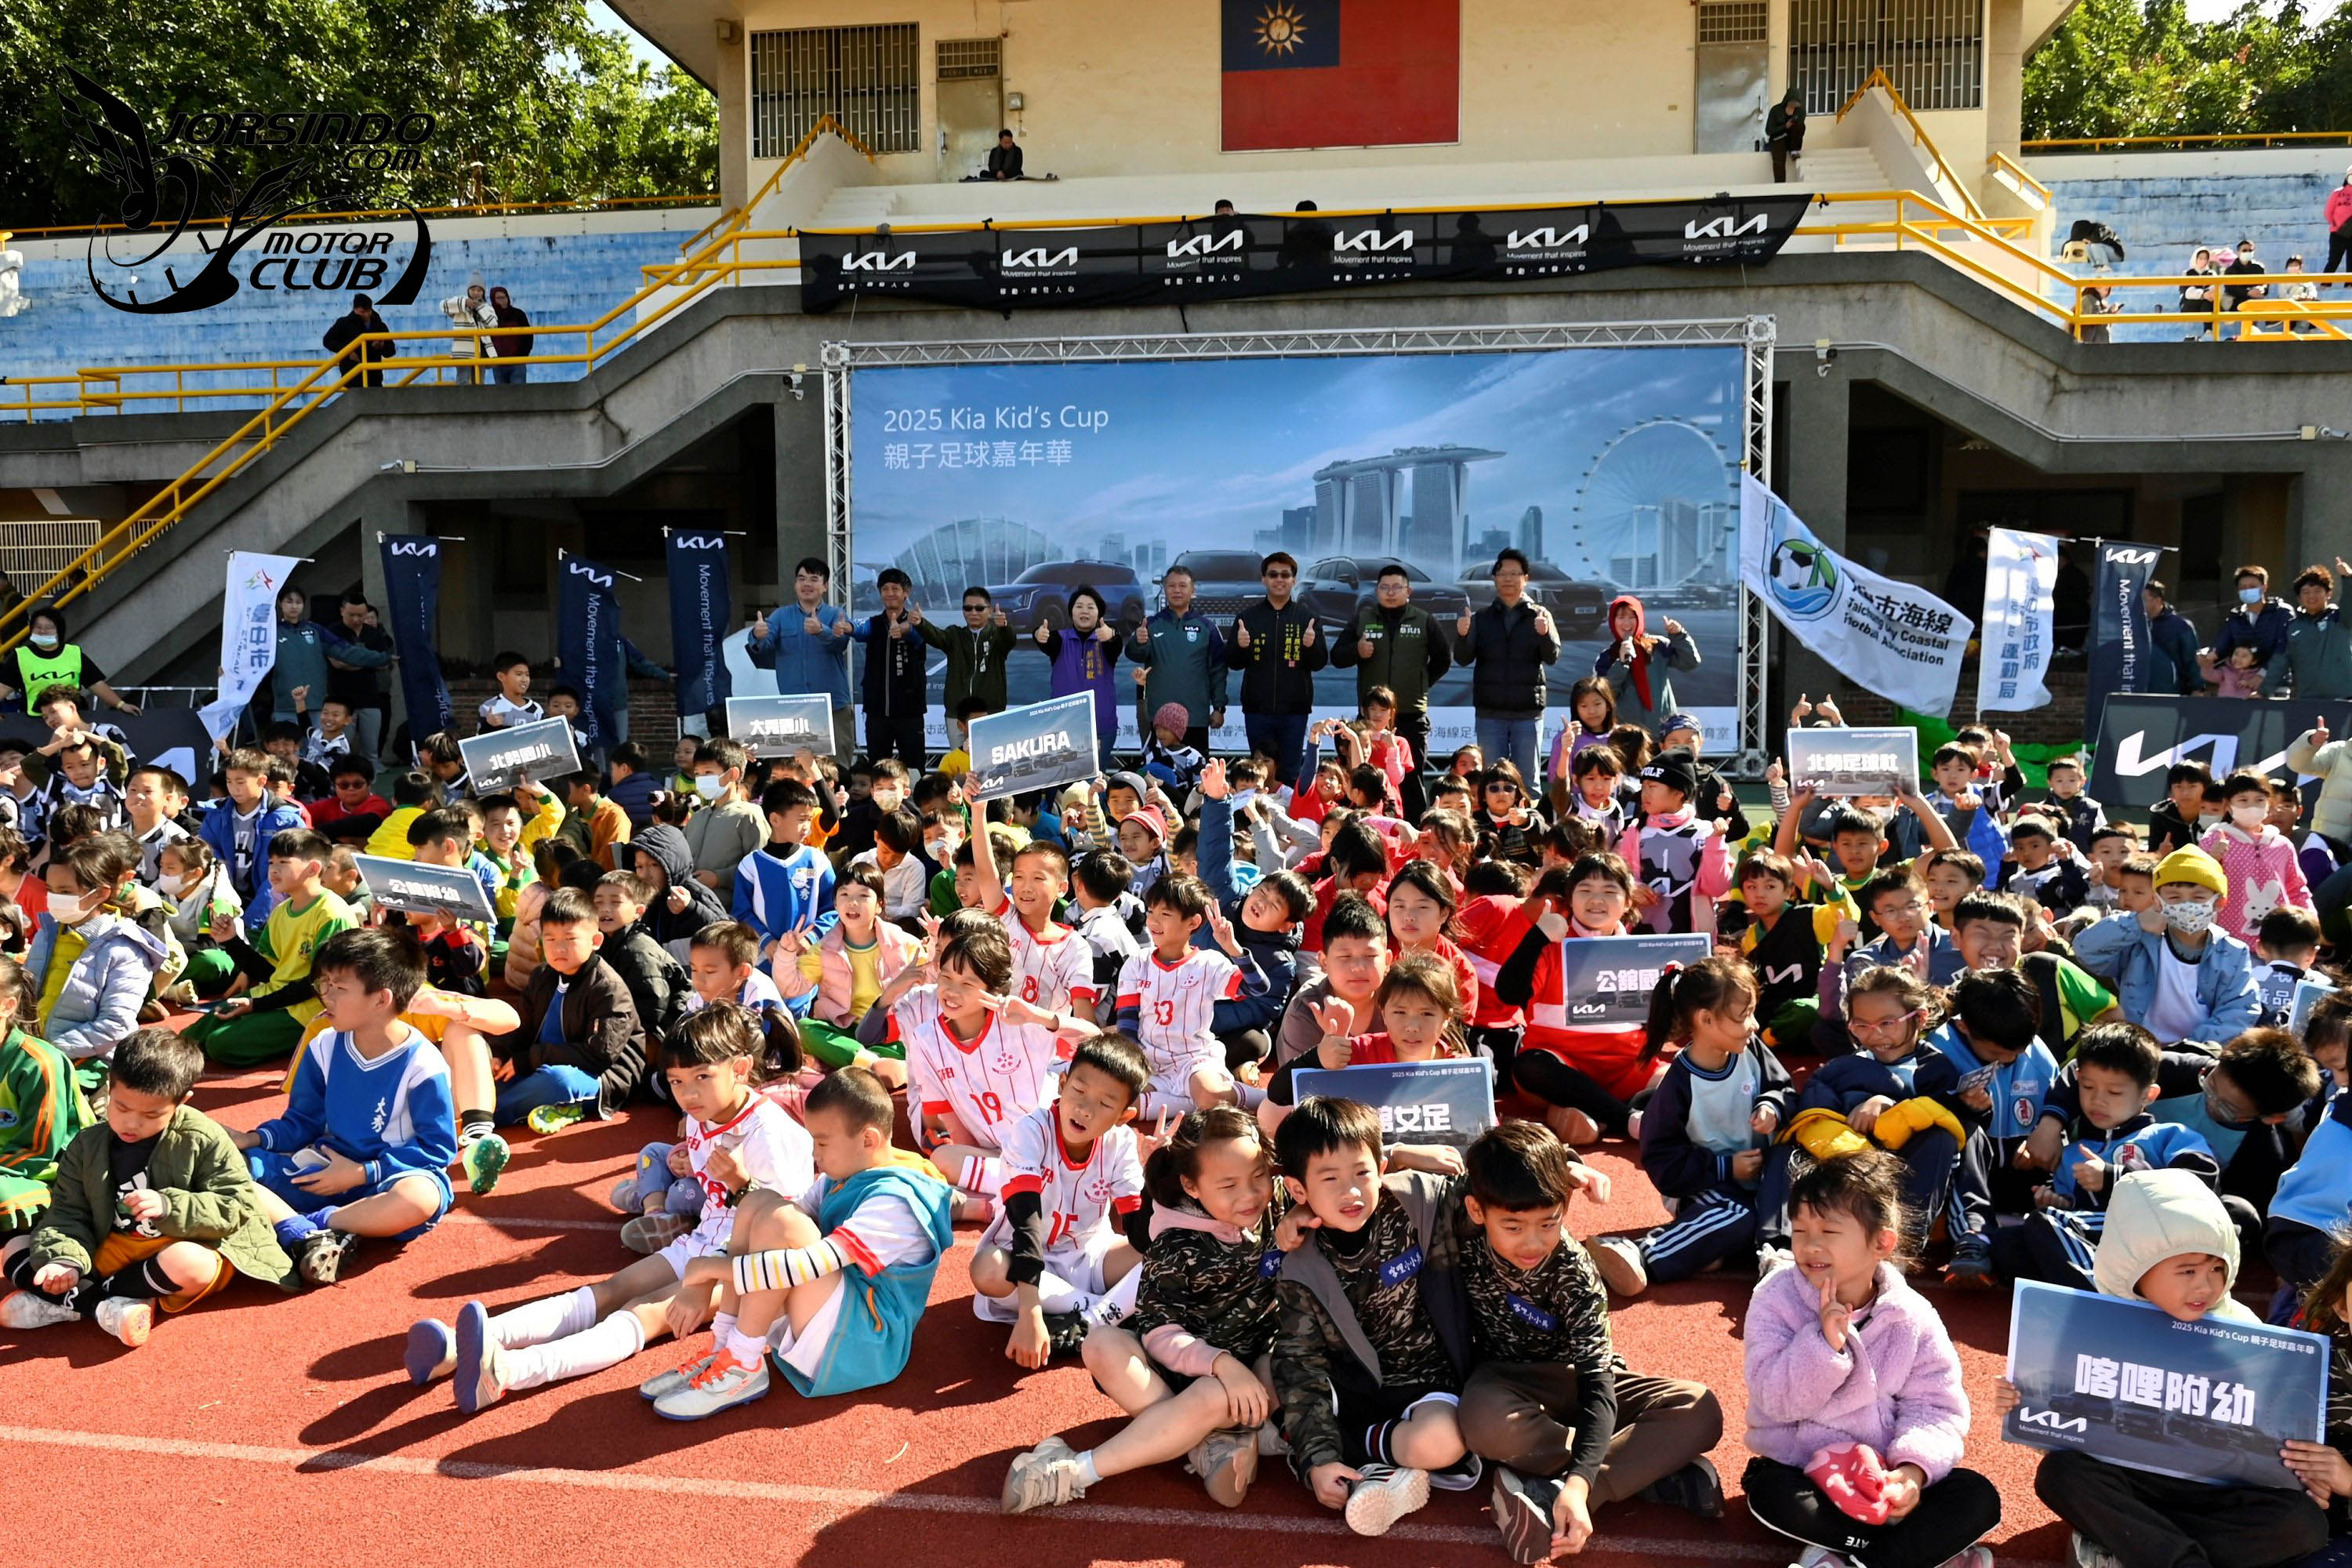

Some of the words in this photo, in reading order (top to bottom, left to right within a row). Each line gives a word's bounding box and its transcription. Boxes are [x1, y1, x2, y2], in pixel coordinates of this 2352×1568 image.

[1334, 256, 1370, 264] Movement
[1386, 256, 1412, 264] inspires
[1506, 252, 1543, 261] Movement
[1560, 250, 1587, 259] inspires
[1683, 242, 1720, 252] Movement
[884, 409, 942, 432] 2025
[951, 408, 985, 430] Kia
[996, 405, 1051, 429] Kid's
[1060, 405, 1109, 433] Cup
[884, 439, 1072, 470] 親子足球嘉年華
[699, 564, 712, 630] Movement
[586, 593, 601, 662] Movement
[2119, 579, 2135, 649] Movement
[702, 632, 715, 658] that
[1900, 630, 1950, 650] Coastal
[2122, 653, 2136, 680] that
[991, 731, 1071, 765] SAKURA
[1596, 968, 1664, 993] 公館國
[371, 1096, 387, 1134] 大秀
[970, 1091, 1004, 1126] 19
[2171, 1320, 2193, 1332] 2025
[2194, 1325, 2209, 1335] Kia
[2209, 1327, 2230, 1340] Kid's
[2231, 1332, 2249, 1345] Cup
[2074, 1353, 2256, 1427] 喀哩附幼
